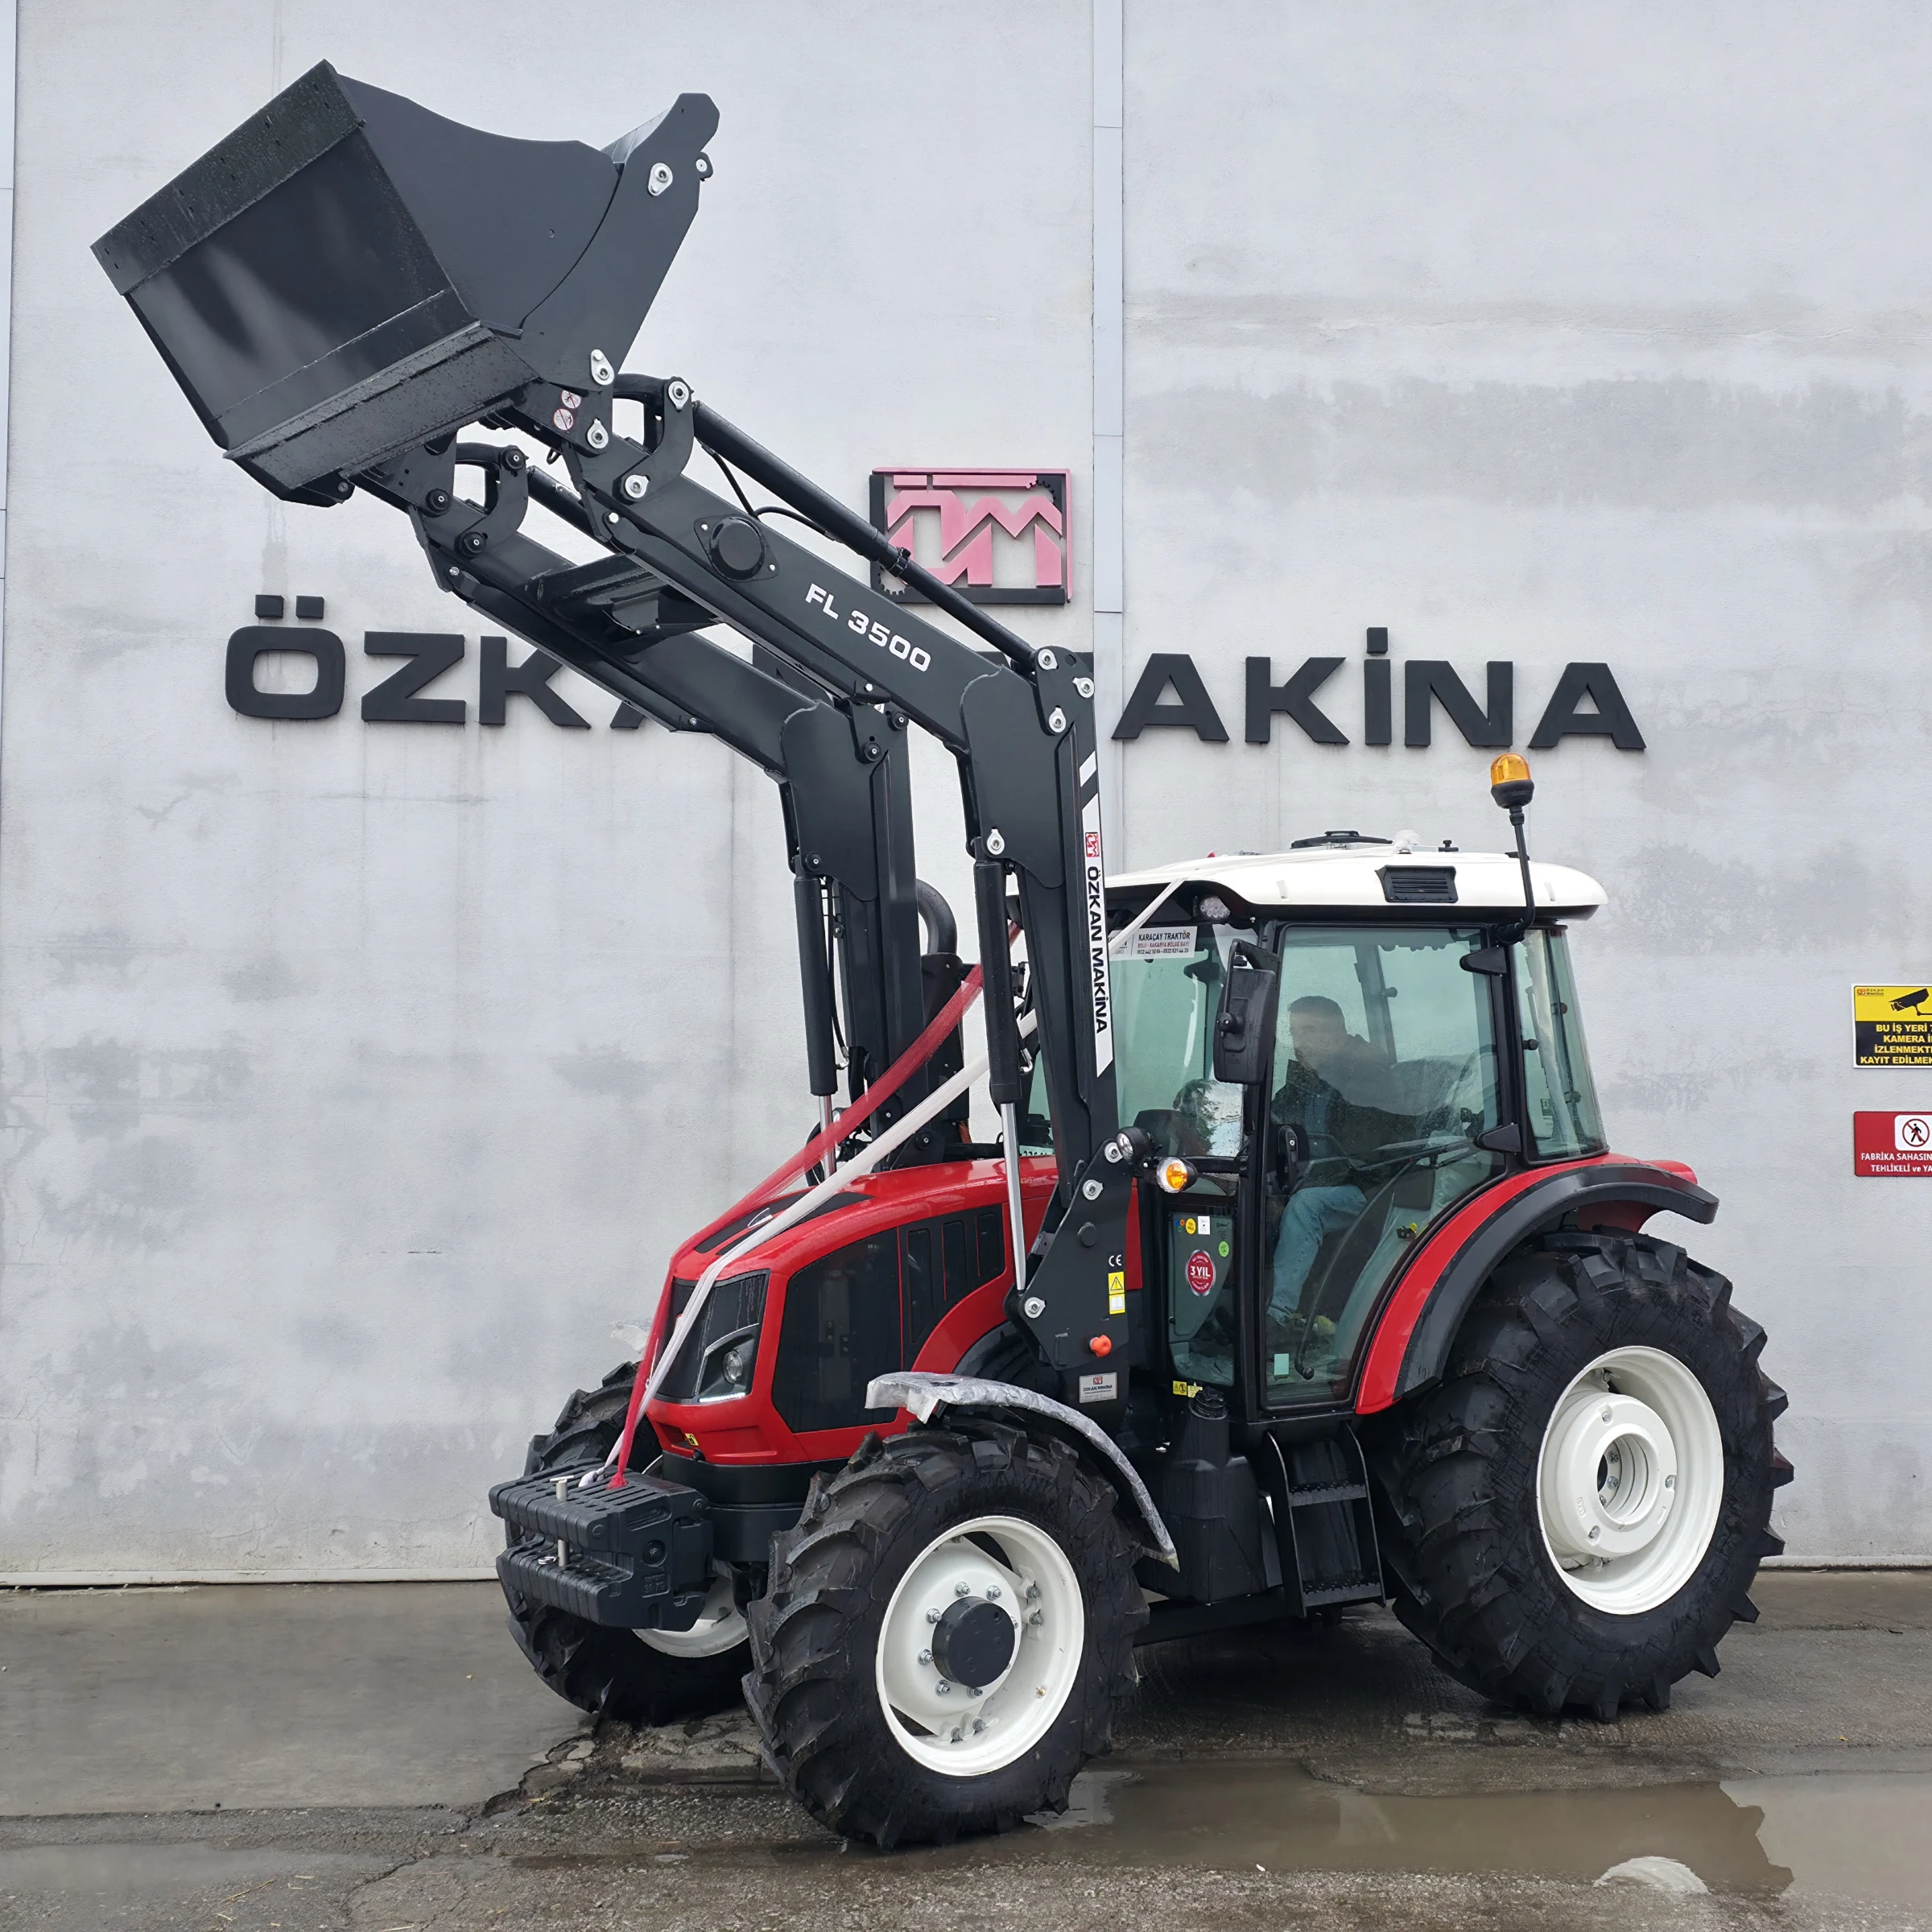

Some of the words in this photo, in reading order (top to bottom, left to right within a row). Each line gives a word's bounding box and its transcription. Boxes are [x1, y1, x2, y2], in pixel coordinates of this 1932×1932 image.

[805, 583, 839, 620] FL
[848, 609, 931, 672] 3500
[1074, 627, 1647, 749] AKİNA
[1087, 865, 1102, 941] ÖZKAN
[1138, 933, 1163, 941] KARAÇAY
[1164, 931, 1191, 939] TRAKTÖR
[1091, 947, 1108, 1034] MAKİNA
[1876, 1024, 1890, 1032] BU
[1893, 1022, 1902, 1034] İŞ
[1905, 1022, 1928, 1032] YERİ
[1861, 1152, 1894, 1160] FABRİKA
[1871, 1163, 1910, 1171] TEHLİKELİ
[1108, 1254, 1122, 1266] CE
[1191, 1266, 1195, 1275] 3
[1196, 1266, 1211, 1278] YIL
